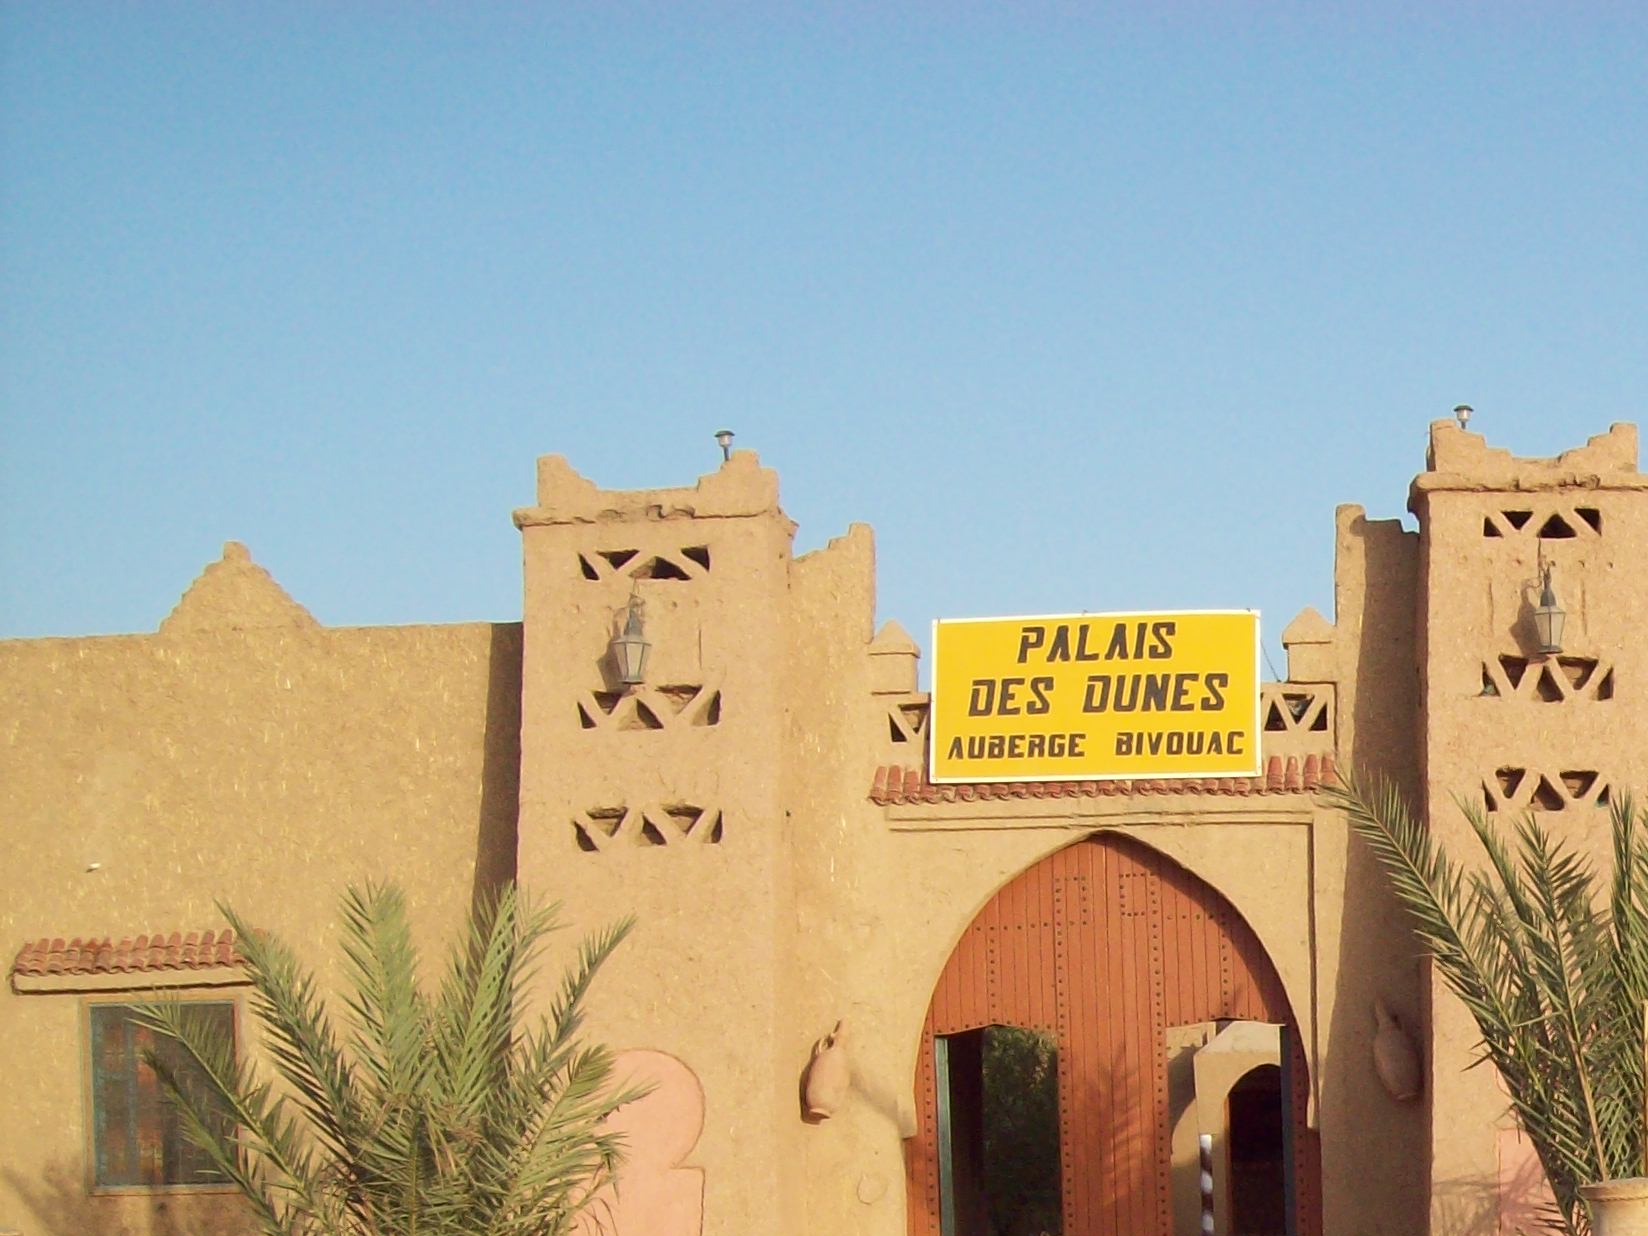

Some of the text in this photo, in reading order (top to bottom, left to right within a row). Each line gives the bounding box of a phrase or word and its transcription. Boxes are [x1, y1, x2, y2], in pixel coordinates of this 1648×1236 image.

[1017, 621, 1177, 663] PALAIS
[968, 673, 1229, 717] DES DUNES
[948, 731, 1245, 760] AUBERGE BIVOUAC
